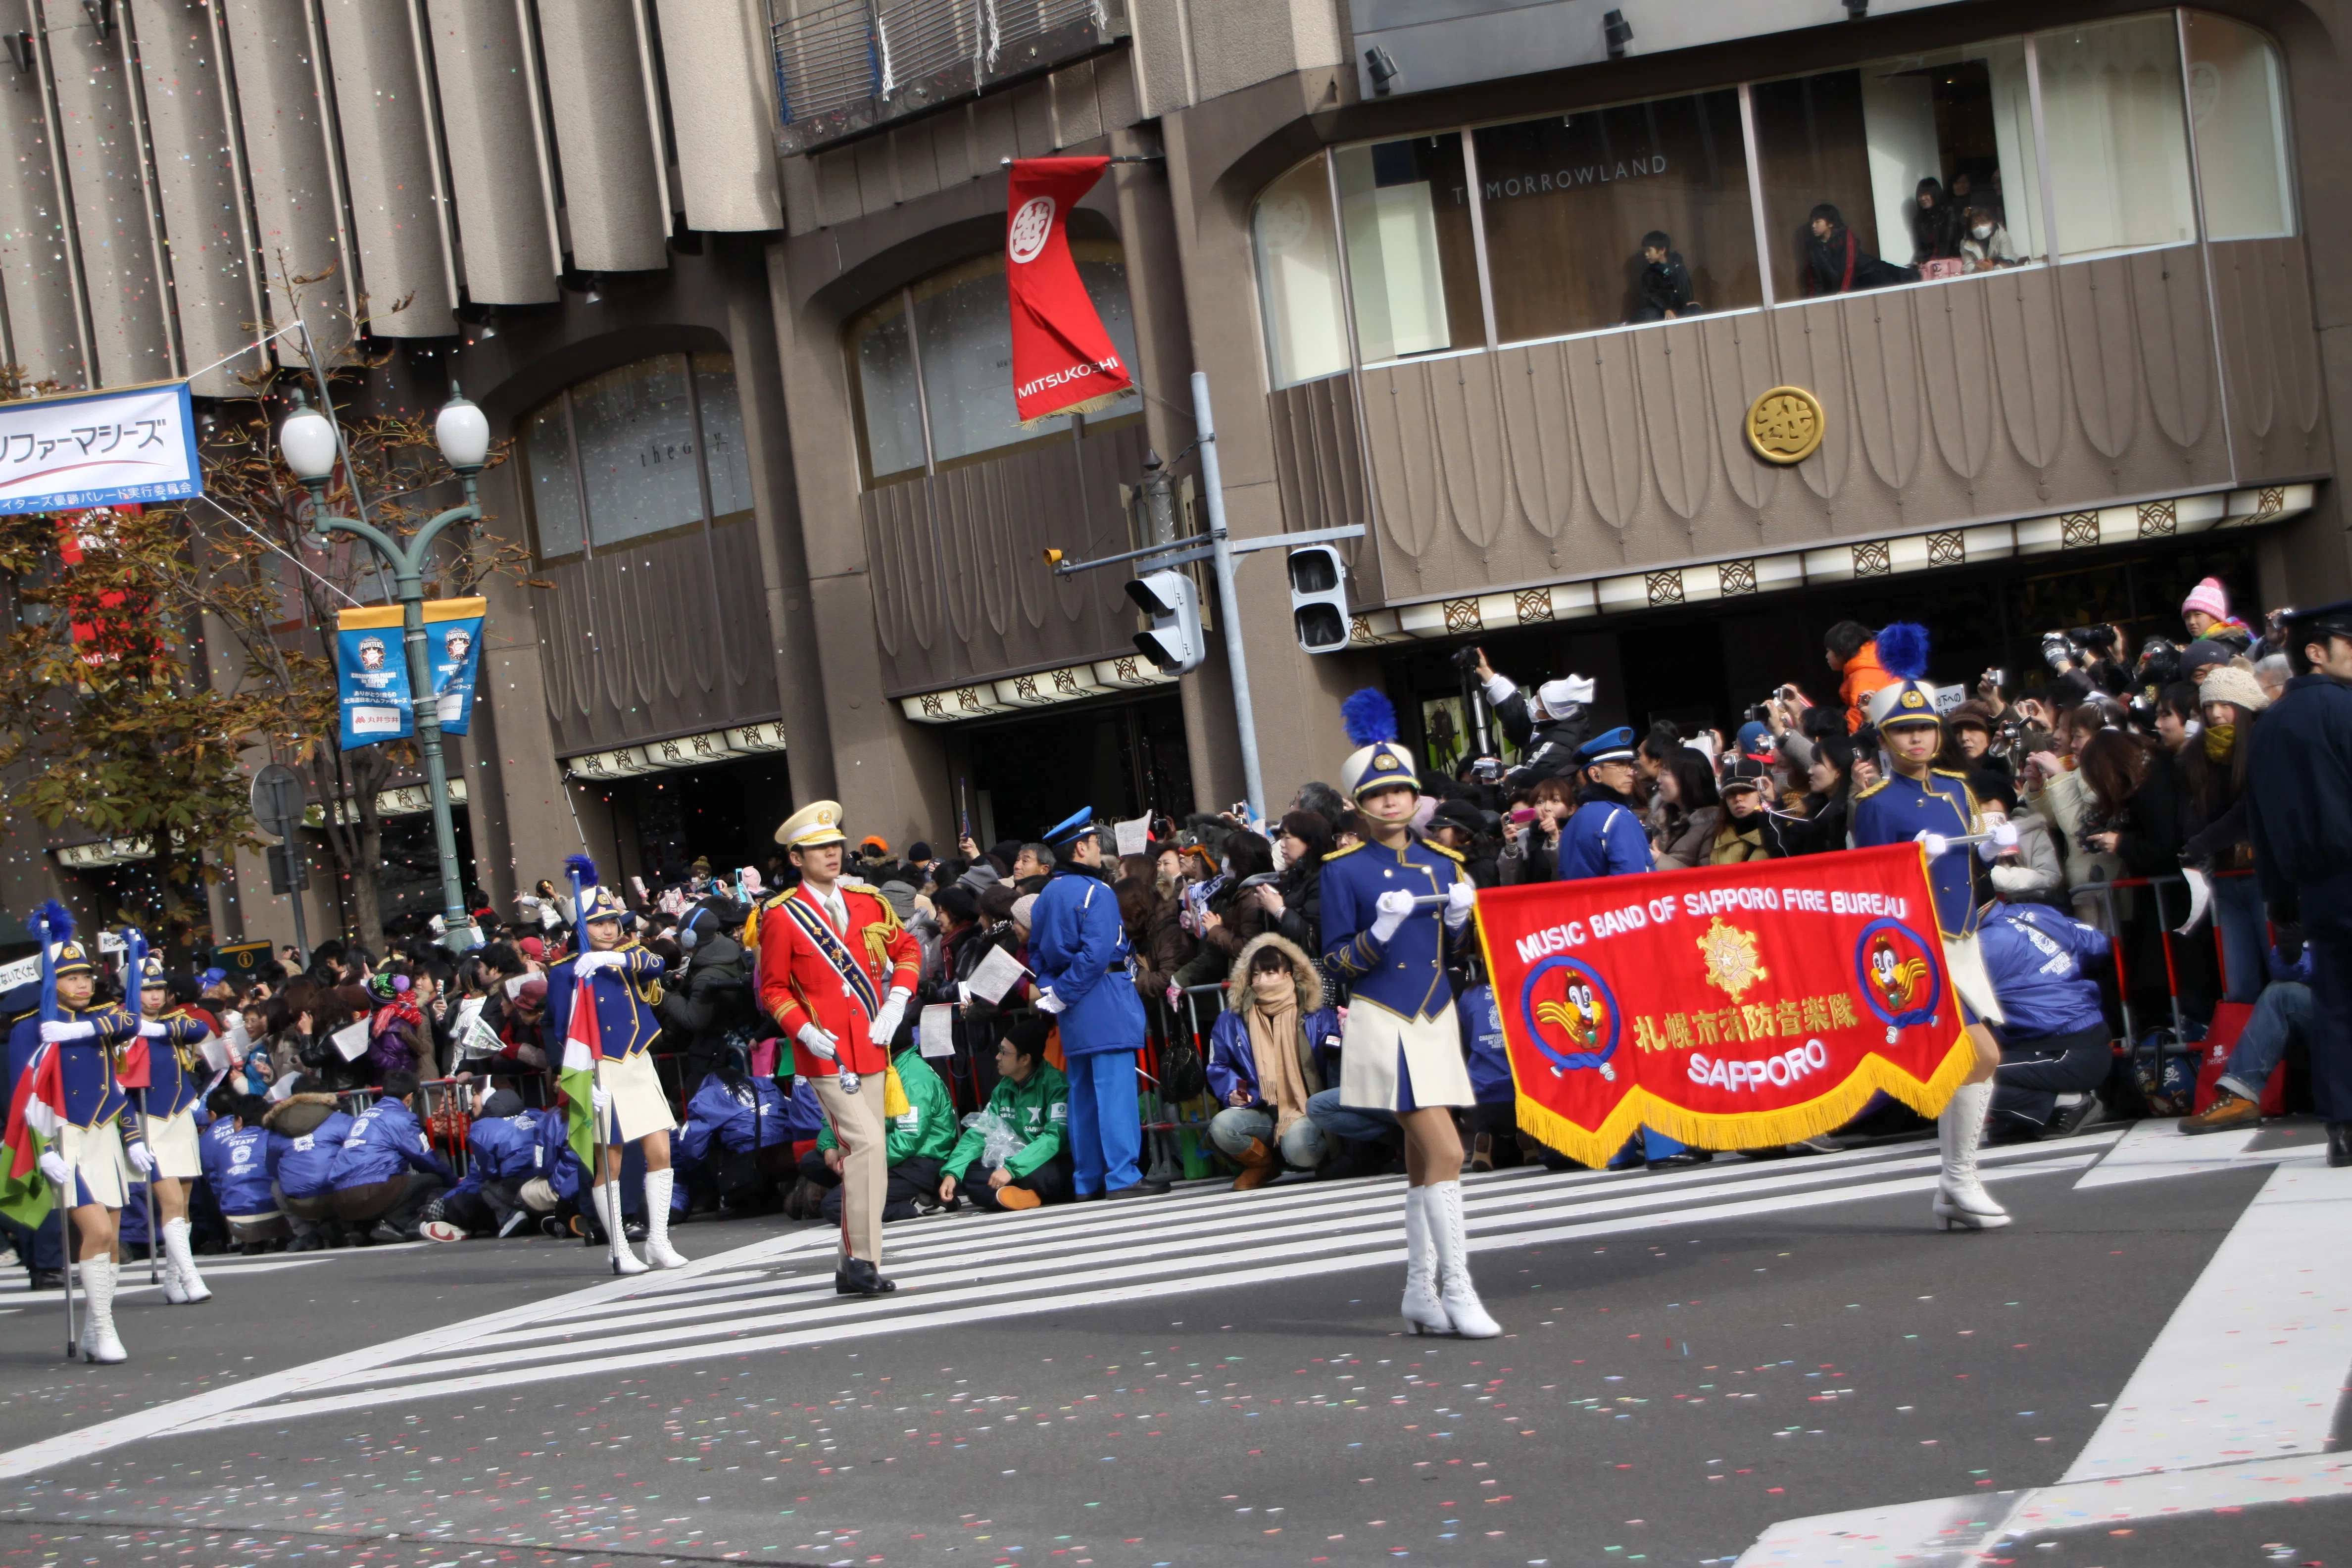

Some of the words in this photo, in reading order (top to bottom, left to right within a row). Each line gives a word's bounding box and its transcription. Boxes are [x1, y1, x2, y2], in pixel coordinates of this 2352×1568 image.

[1018, 356, 1119, 399] MITSUKOSHI
[641, 433, 722, 467] theoy
[360, 641, 384, 650] FIGHTERS
[447, 632, 470, 641] FIGHTERS
[1516, 921, 1585, 963] MUSIC
[1589, 905, 1646, 938] BAND
[1648, 895, 1676, 923] OF
[1683, 887, 1779, 916] SAPPORO
[1782, 888, 1828, 912] FIRE
[1830, 891, 1906, 920] BUREAU
[0, 963, 35, 986] ないでくだ
[1633, 992, 1859, 1054] 札幌市消防音楽隊
[1687, 1038, 1825, 1092] SAPPORO
[229, 1137, 258, 1147] STAFF
